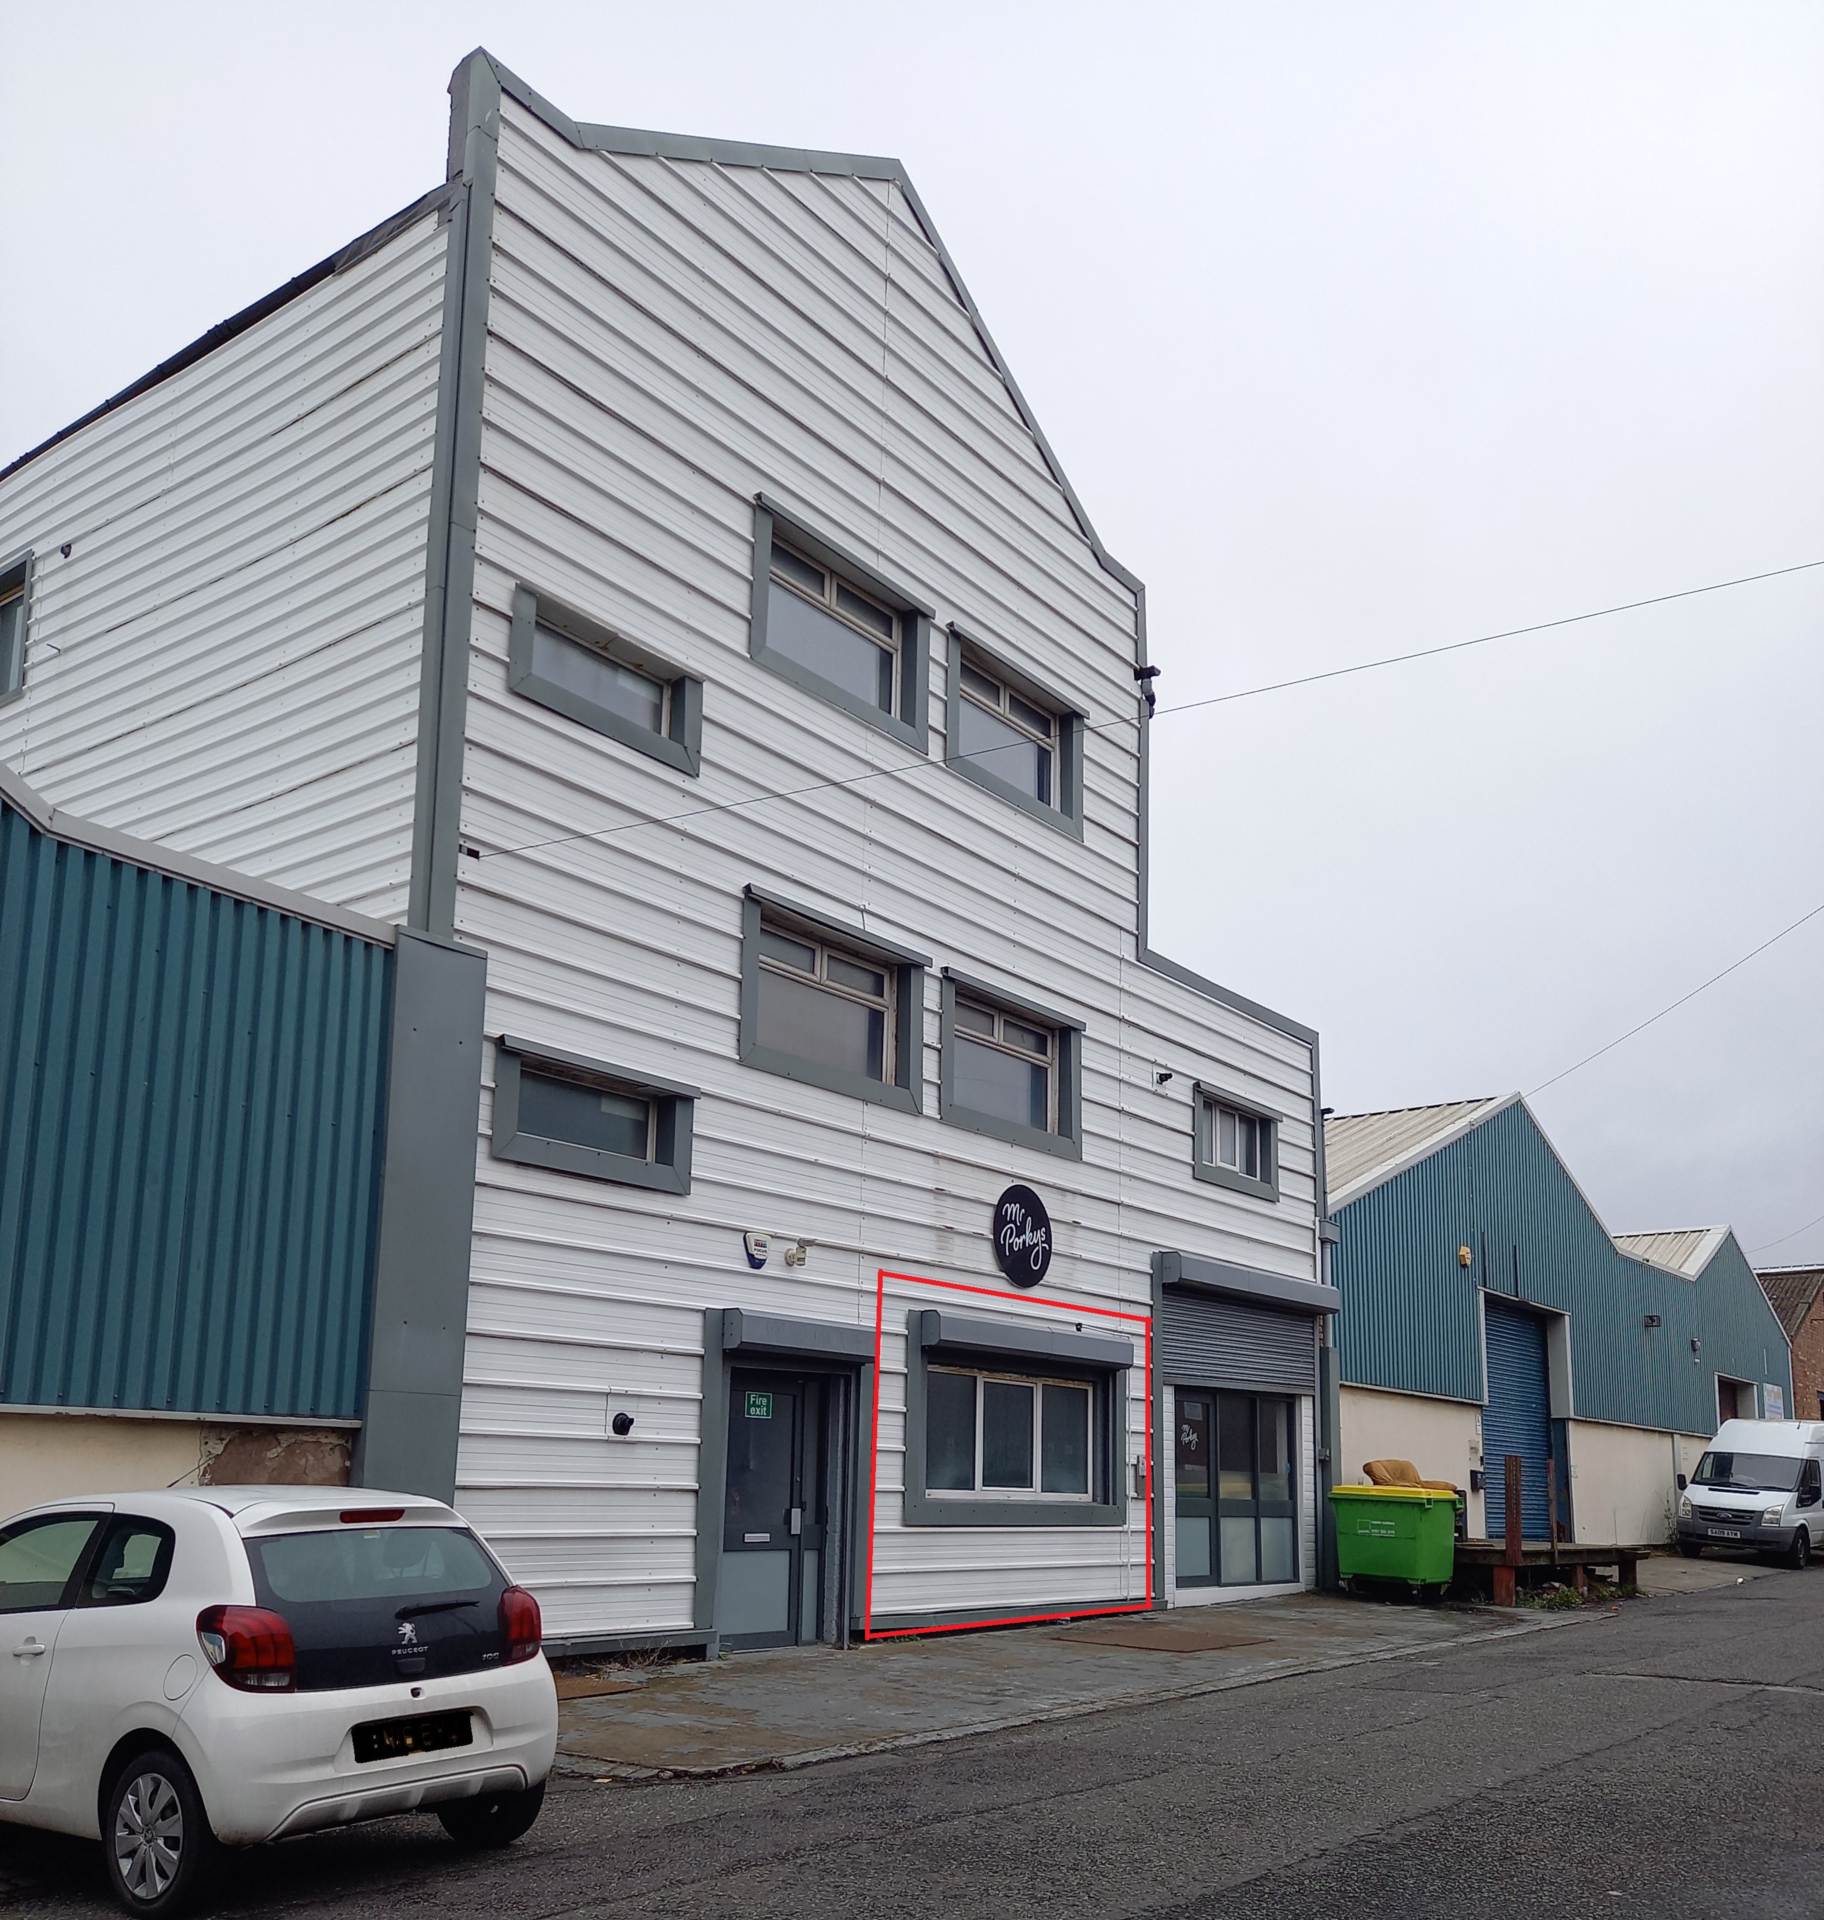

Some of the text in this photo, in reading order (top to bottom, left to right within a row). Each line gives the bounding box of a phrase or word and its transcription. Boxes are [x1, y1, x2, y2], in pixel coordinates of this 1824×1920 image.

[1002, 1203, 1025, 1226] Mr
[1000, 1216, 1049, 1270] Porkys
[750, 1394, 767, 1406] Fire
[750, 1406, 767, 1416] exit
[391, 1646, 429, 1655] PEUGEOT
